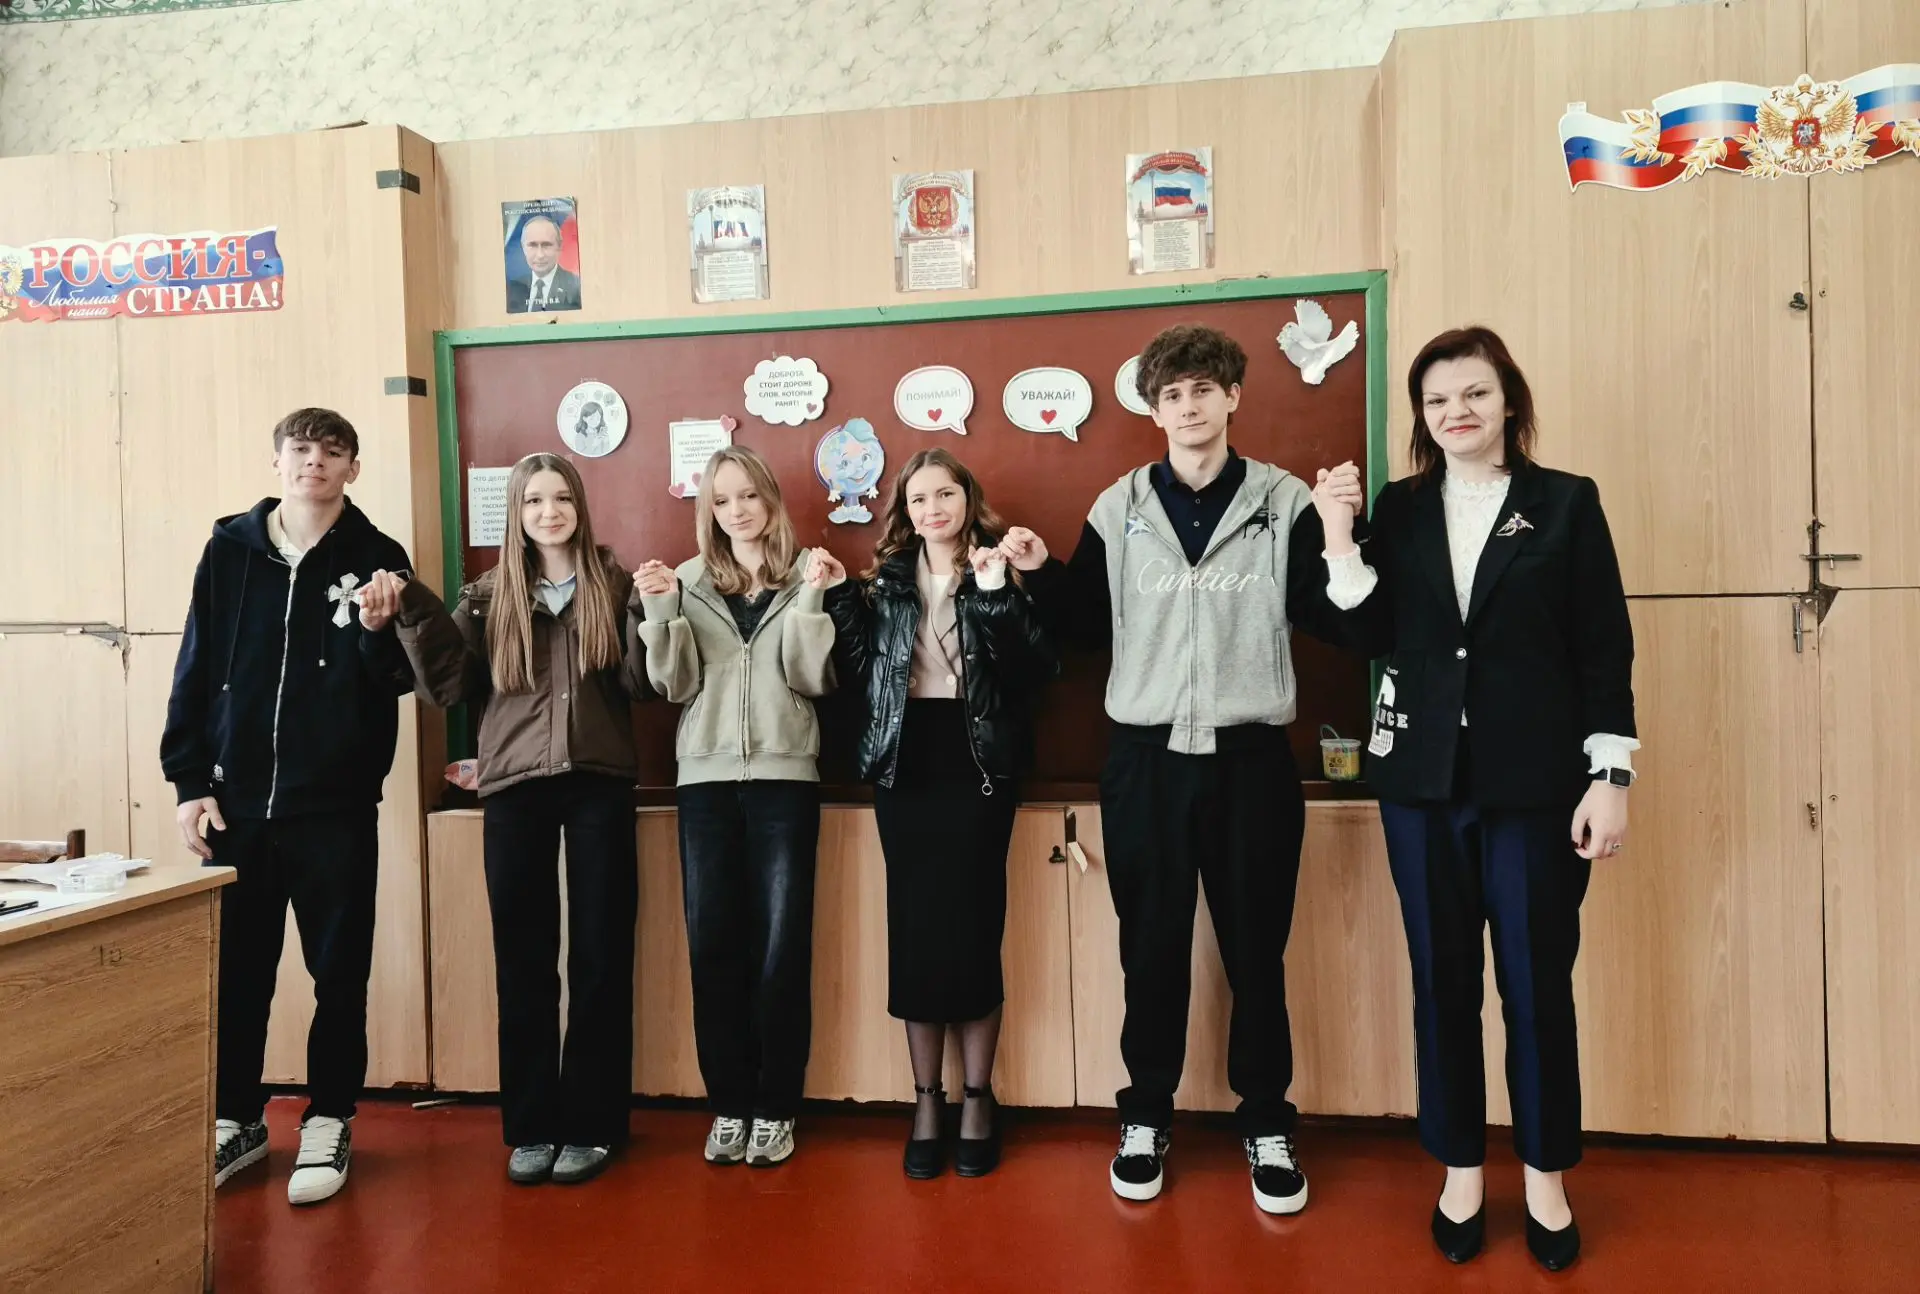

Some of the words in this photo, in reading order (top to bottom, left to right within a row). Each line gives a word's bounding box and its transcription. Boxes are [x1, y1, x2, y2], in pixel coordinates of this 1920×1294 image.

[29, 234, 266, 288] РОССИЯ-
[28, 279, 120, 308] Любимая
[126, 281, 281, 315] СТРАНА!
[67, 306, 110, 318] наша
[768, 370, 804, 379] ДОБРОТА
[783, 380, 813, 388] ДОРОЖЕ
[906, 387, 961, 402] ПОНИМАЙ!
[1020, 387, 1076, 402] УВАЖАЙ!
